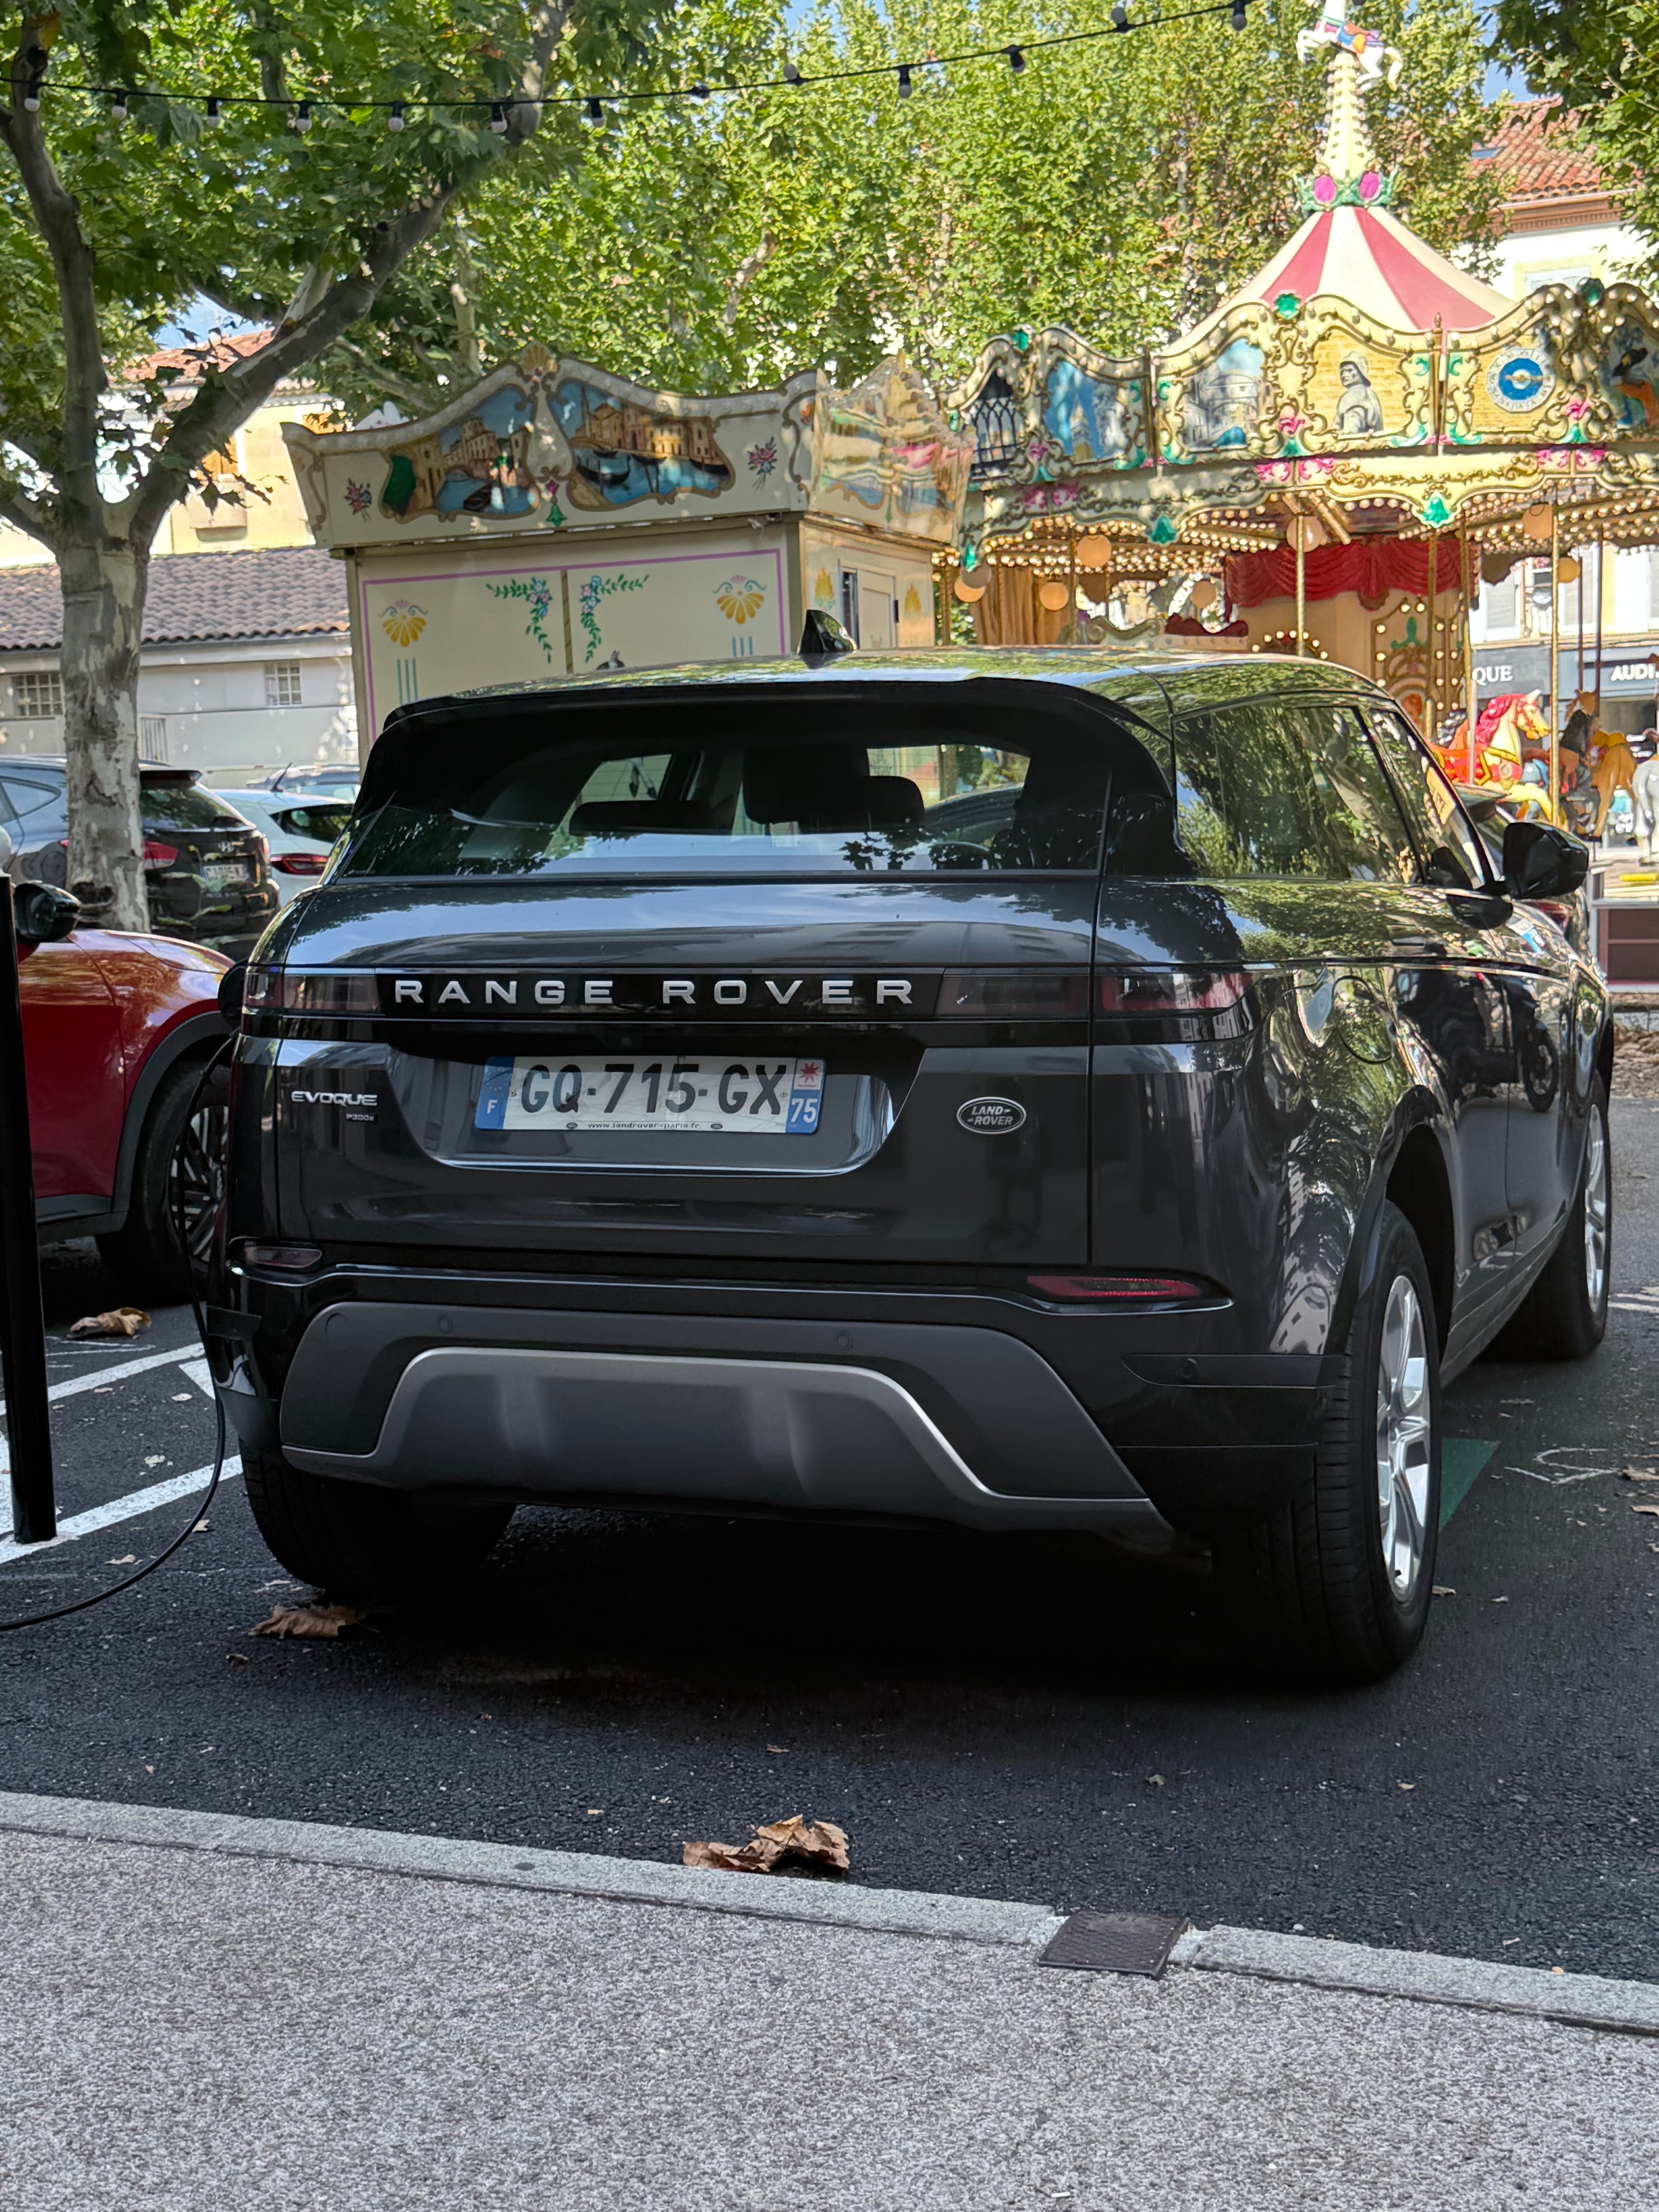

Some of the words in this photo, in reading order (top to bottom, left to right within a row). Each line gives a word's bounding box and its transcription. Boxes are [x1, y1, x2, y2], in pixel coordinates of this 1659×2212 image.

[1611, 663, 1659, 681] AUDI
[395, 980, 613, 1004] RANGE
[662, 980, 912, 1004] ROVER
[292, 1091, 378, 1106] EVOQUE
[521, 1063, 787, 1114] GQ-715-GX
[487, 1099, 498, 1114] F
[791, 1098, 818, 1123] 75
